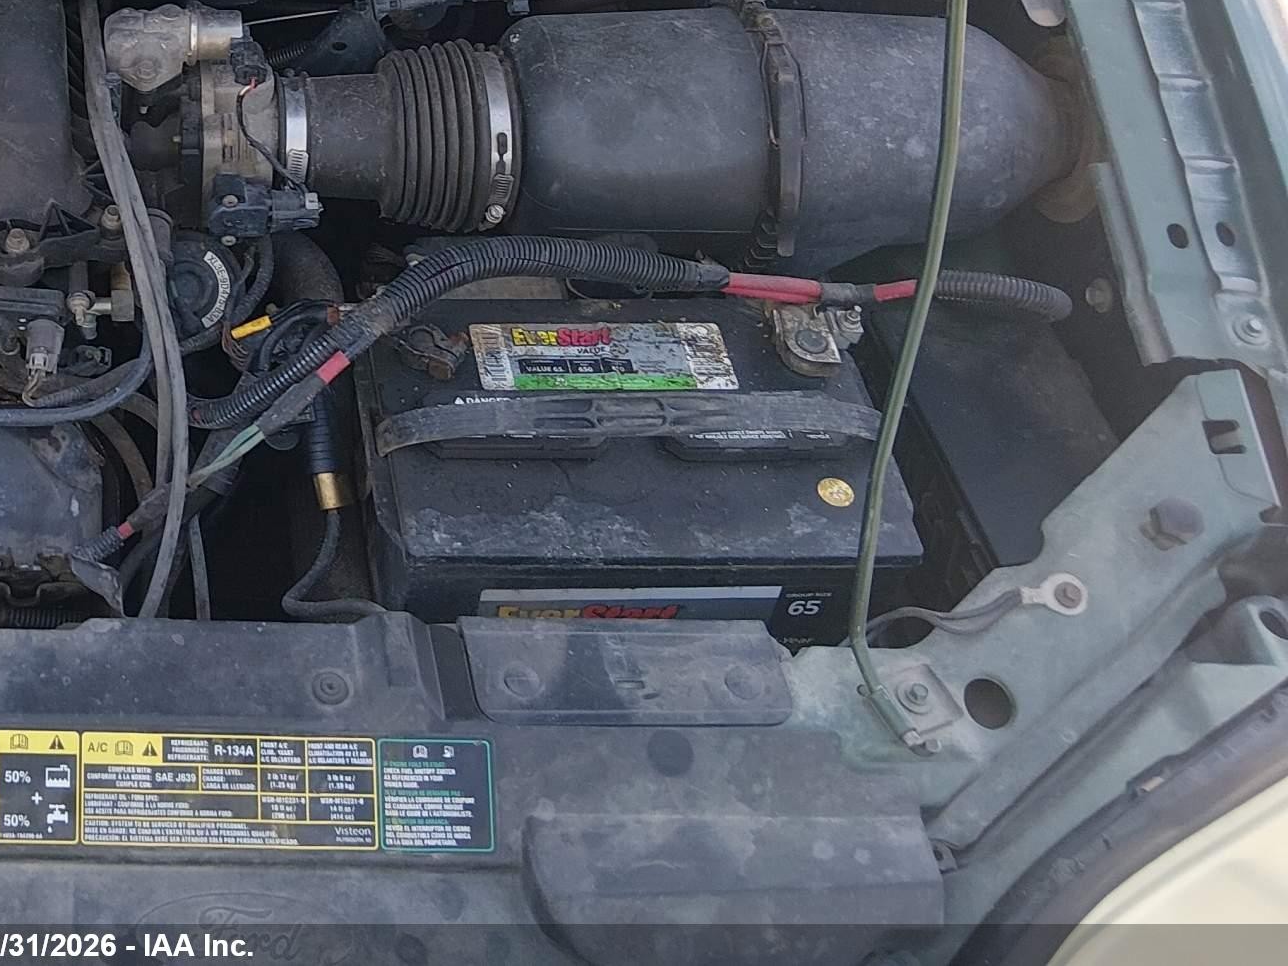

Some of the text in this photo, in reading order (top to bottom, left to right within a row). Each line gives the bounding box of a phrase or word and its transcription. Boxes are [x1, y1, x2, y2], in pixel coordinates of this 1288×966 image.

[512, 327, 610, 346] EverStart
[577, 347, 606, 355] VALUE
[787, 600, 821, 615] 65
[87, 742, 108, 753] A/C
[214, 744, 255, 757] R-134A
[4, 770, 31, 784] 50%
[155, 772, 174, 782] SAE
[3, 814, 30, 828] 50%
[335, 826, 372, 836] Visteon
